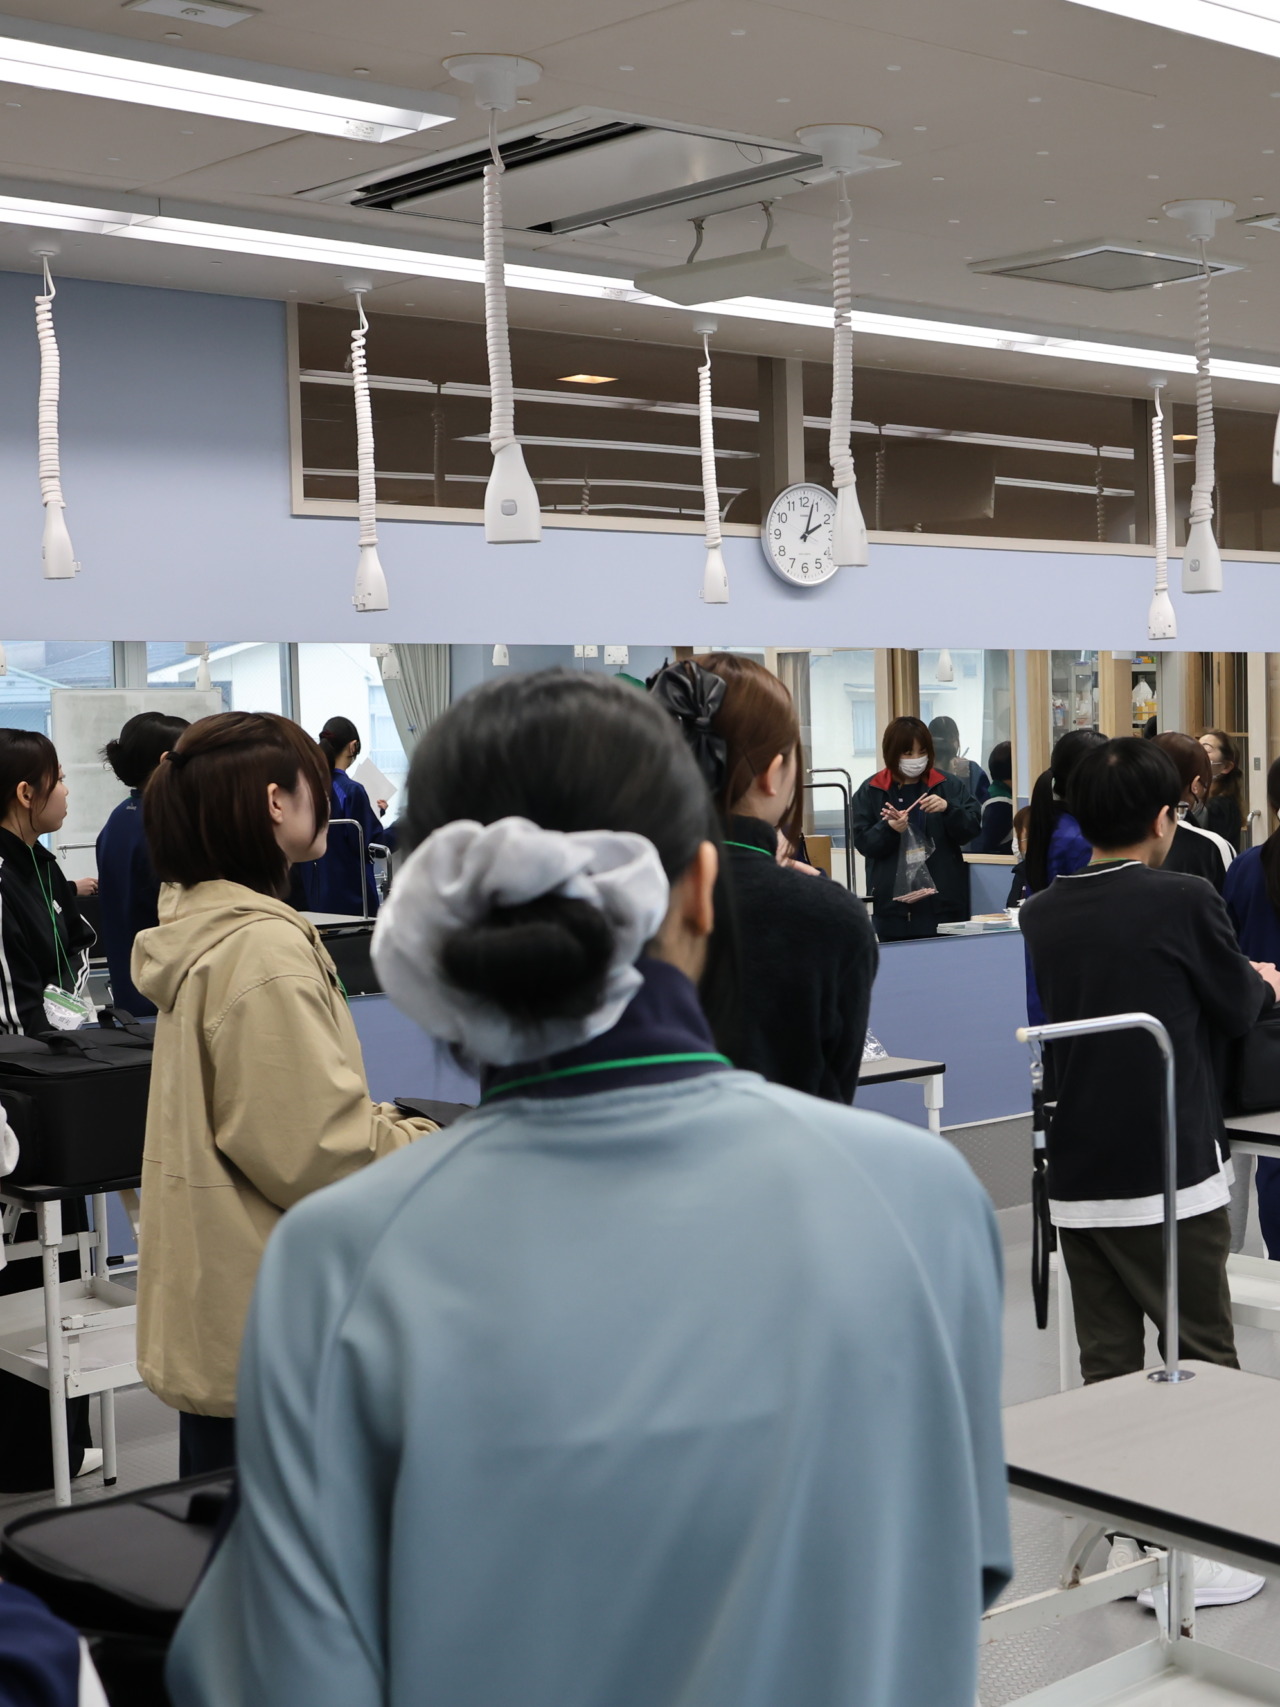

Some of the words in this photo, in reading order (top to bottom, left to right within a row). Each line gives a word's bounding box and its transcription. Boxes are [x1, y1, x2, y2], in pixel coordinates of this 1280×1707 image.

[787, 501, 795, 512] 11
[799, 496, 810, 508] 12
[815, 501, 819, 512] 1
[777, 512, 788, 524] 10
[823, 513, 831, 525] 2
[773, 528, 782, 540] 9
[778, 545, 786, 557] 8
[789, 558, 796, 569] 7
[801, 562, 809, 574] 6
[815, 558, 823, 570] 5
